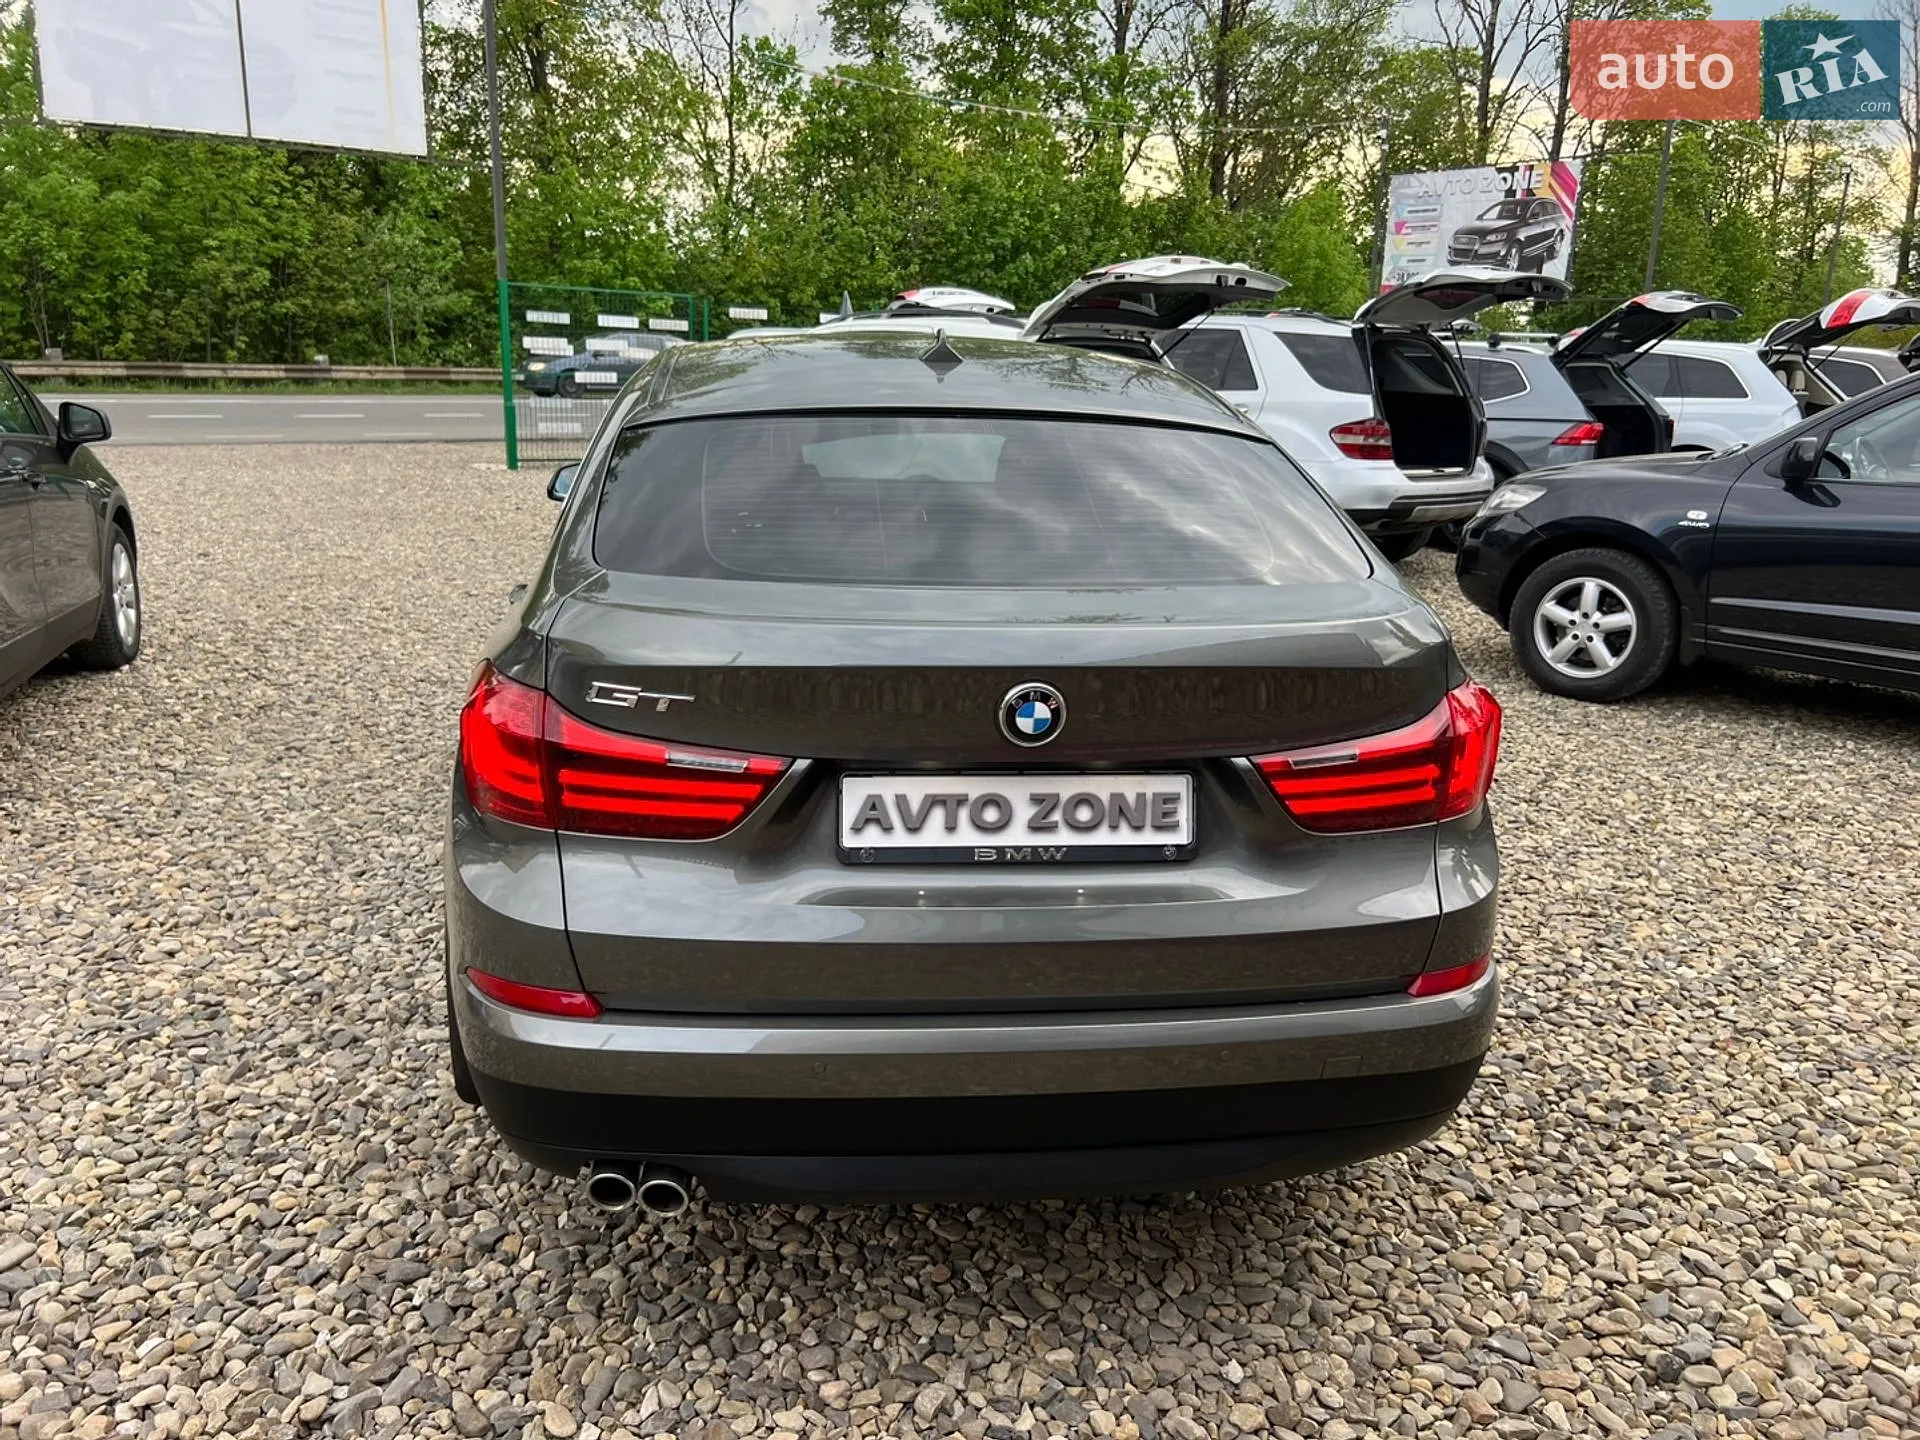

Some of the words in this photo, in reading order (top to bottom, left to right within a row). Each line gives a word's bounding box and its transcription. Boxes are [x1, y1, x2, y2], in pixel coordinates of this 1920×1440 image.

[1478, 171, 1545, 195] ZONE
[585, 681, 697, 712] GT
[1011, 691, 1060, 709] BMW
[849, 792, 1013, 831] AVTO
[1027, 791, 1182, 831] ZONE
[974, 847, 1068, 861] BMW
